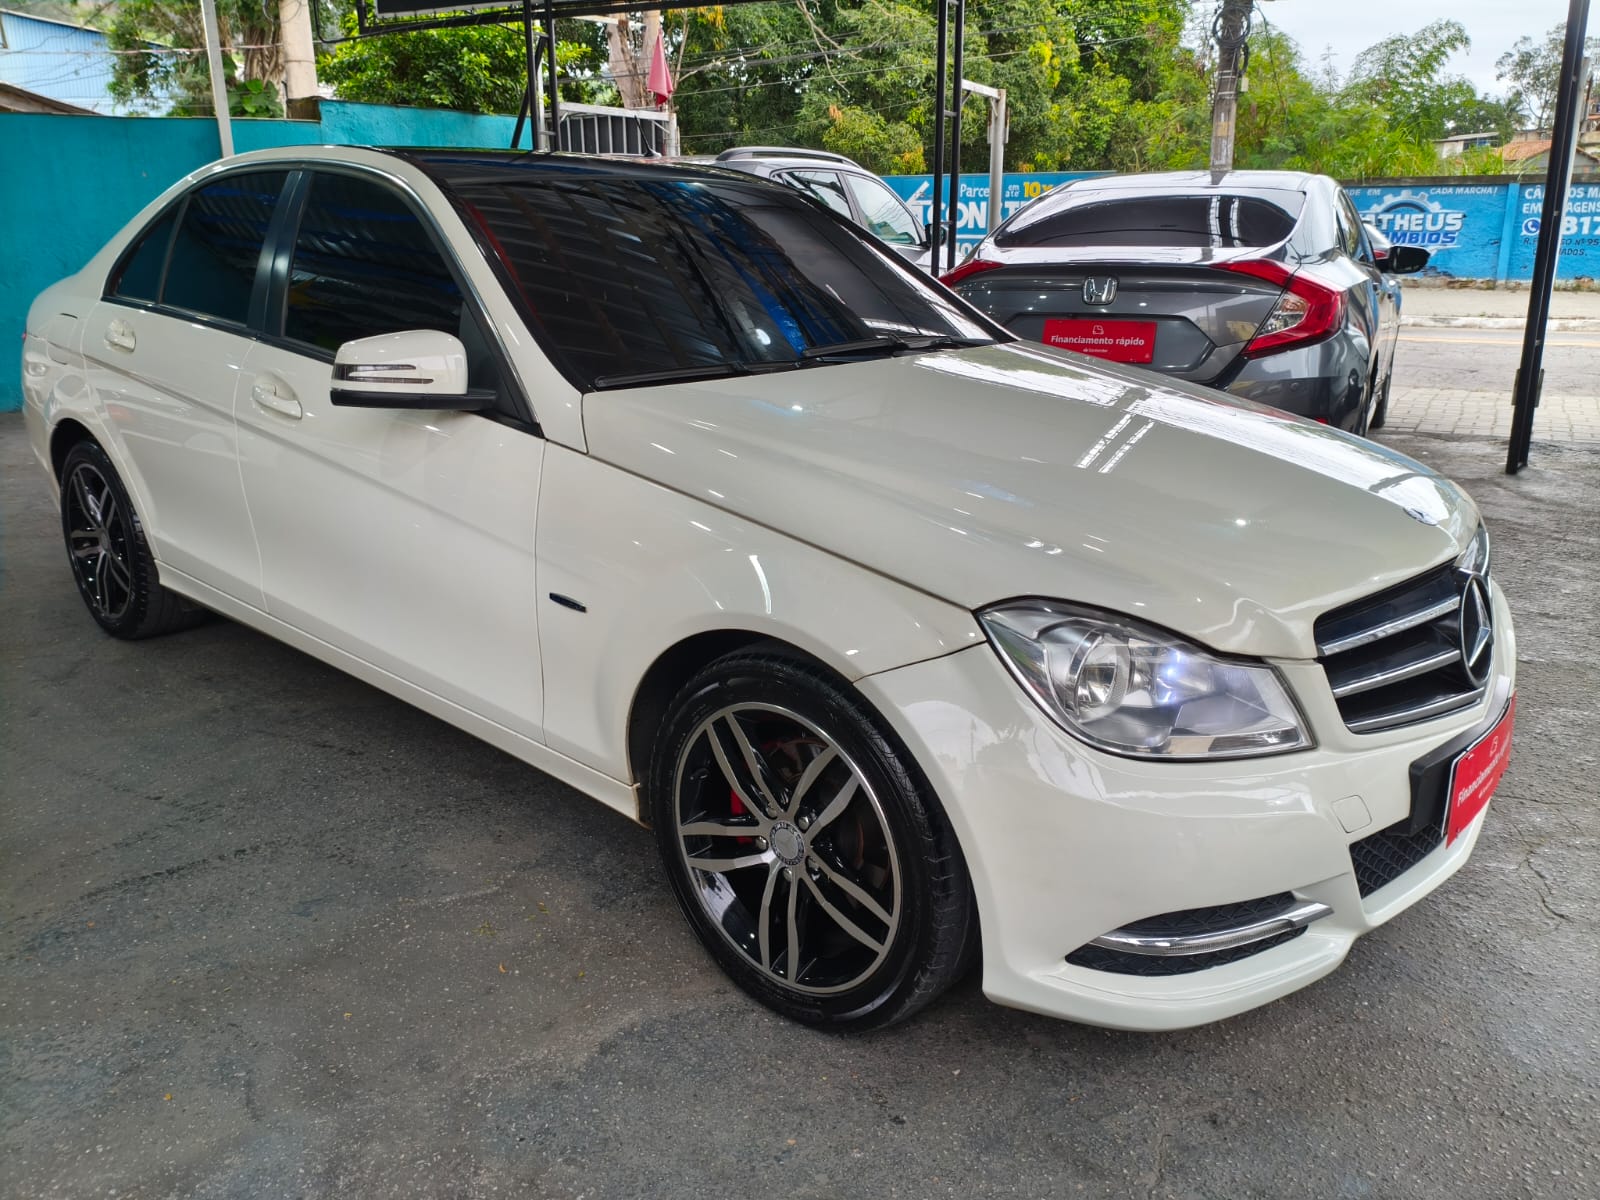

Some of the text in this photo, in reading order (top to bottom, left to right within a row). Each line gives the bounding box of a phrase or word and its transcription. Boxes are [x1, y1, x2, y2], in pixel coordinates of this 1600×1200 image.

[1023, 181, 1041, 198] 10
[1455, 187, 1498, 196] MARCHA!
[1051, 335, 1145, 347] Financiamento rápido
